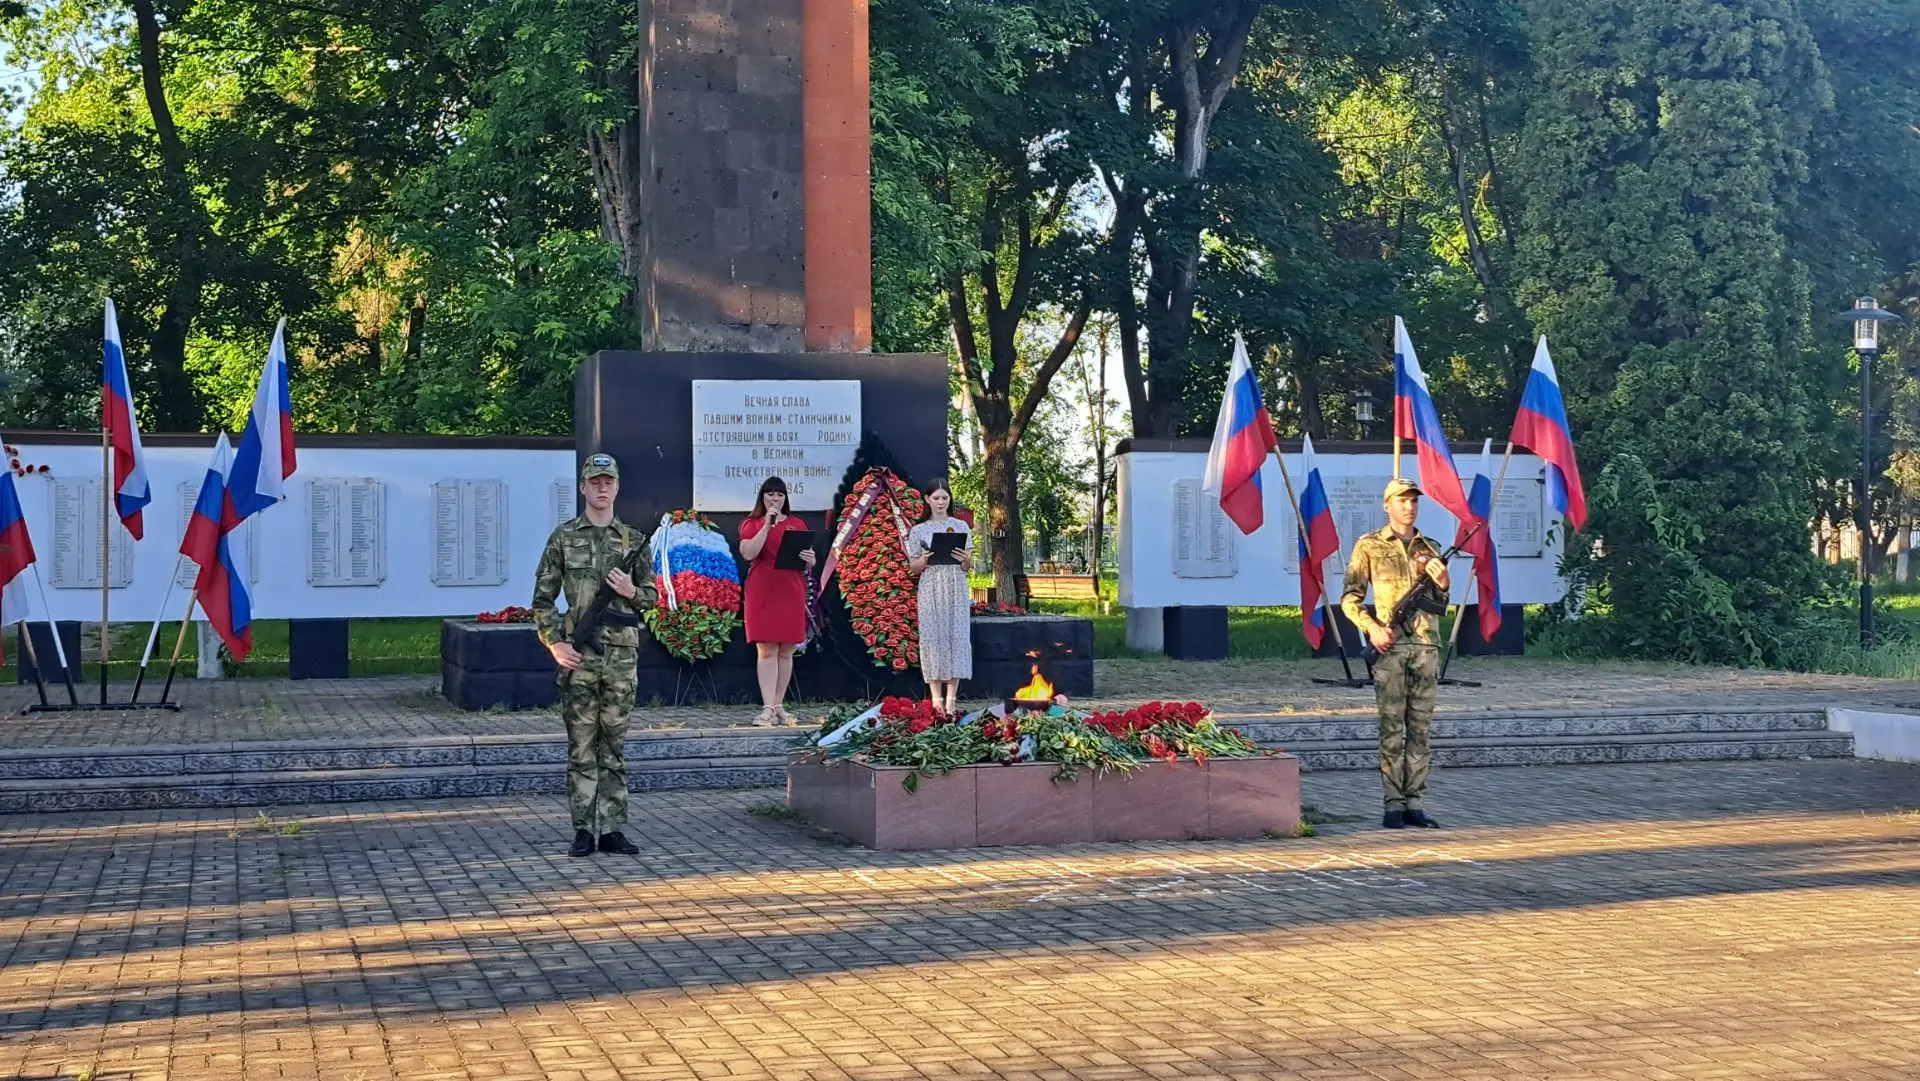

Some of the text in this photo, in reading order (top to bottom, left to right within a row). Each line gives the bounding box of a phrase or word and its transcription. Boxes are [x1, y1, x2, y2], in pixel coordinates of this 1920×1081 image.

[744, 394, 811, 407] ВЕЧНАЯ СЛАВА
[703, 413, 743, 425] ПАВШИМ
[702, 431, 765, 443] ОТСТОЯВШИМ
[776, 431, 799, 442] БОЯХ
[818, 429, 852, 443] РОДИНУ
[804, 465, 832, 477] ВОЙНЕ
